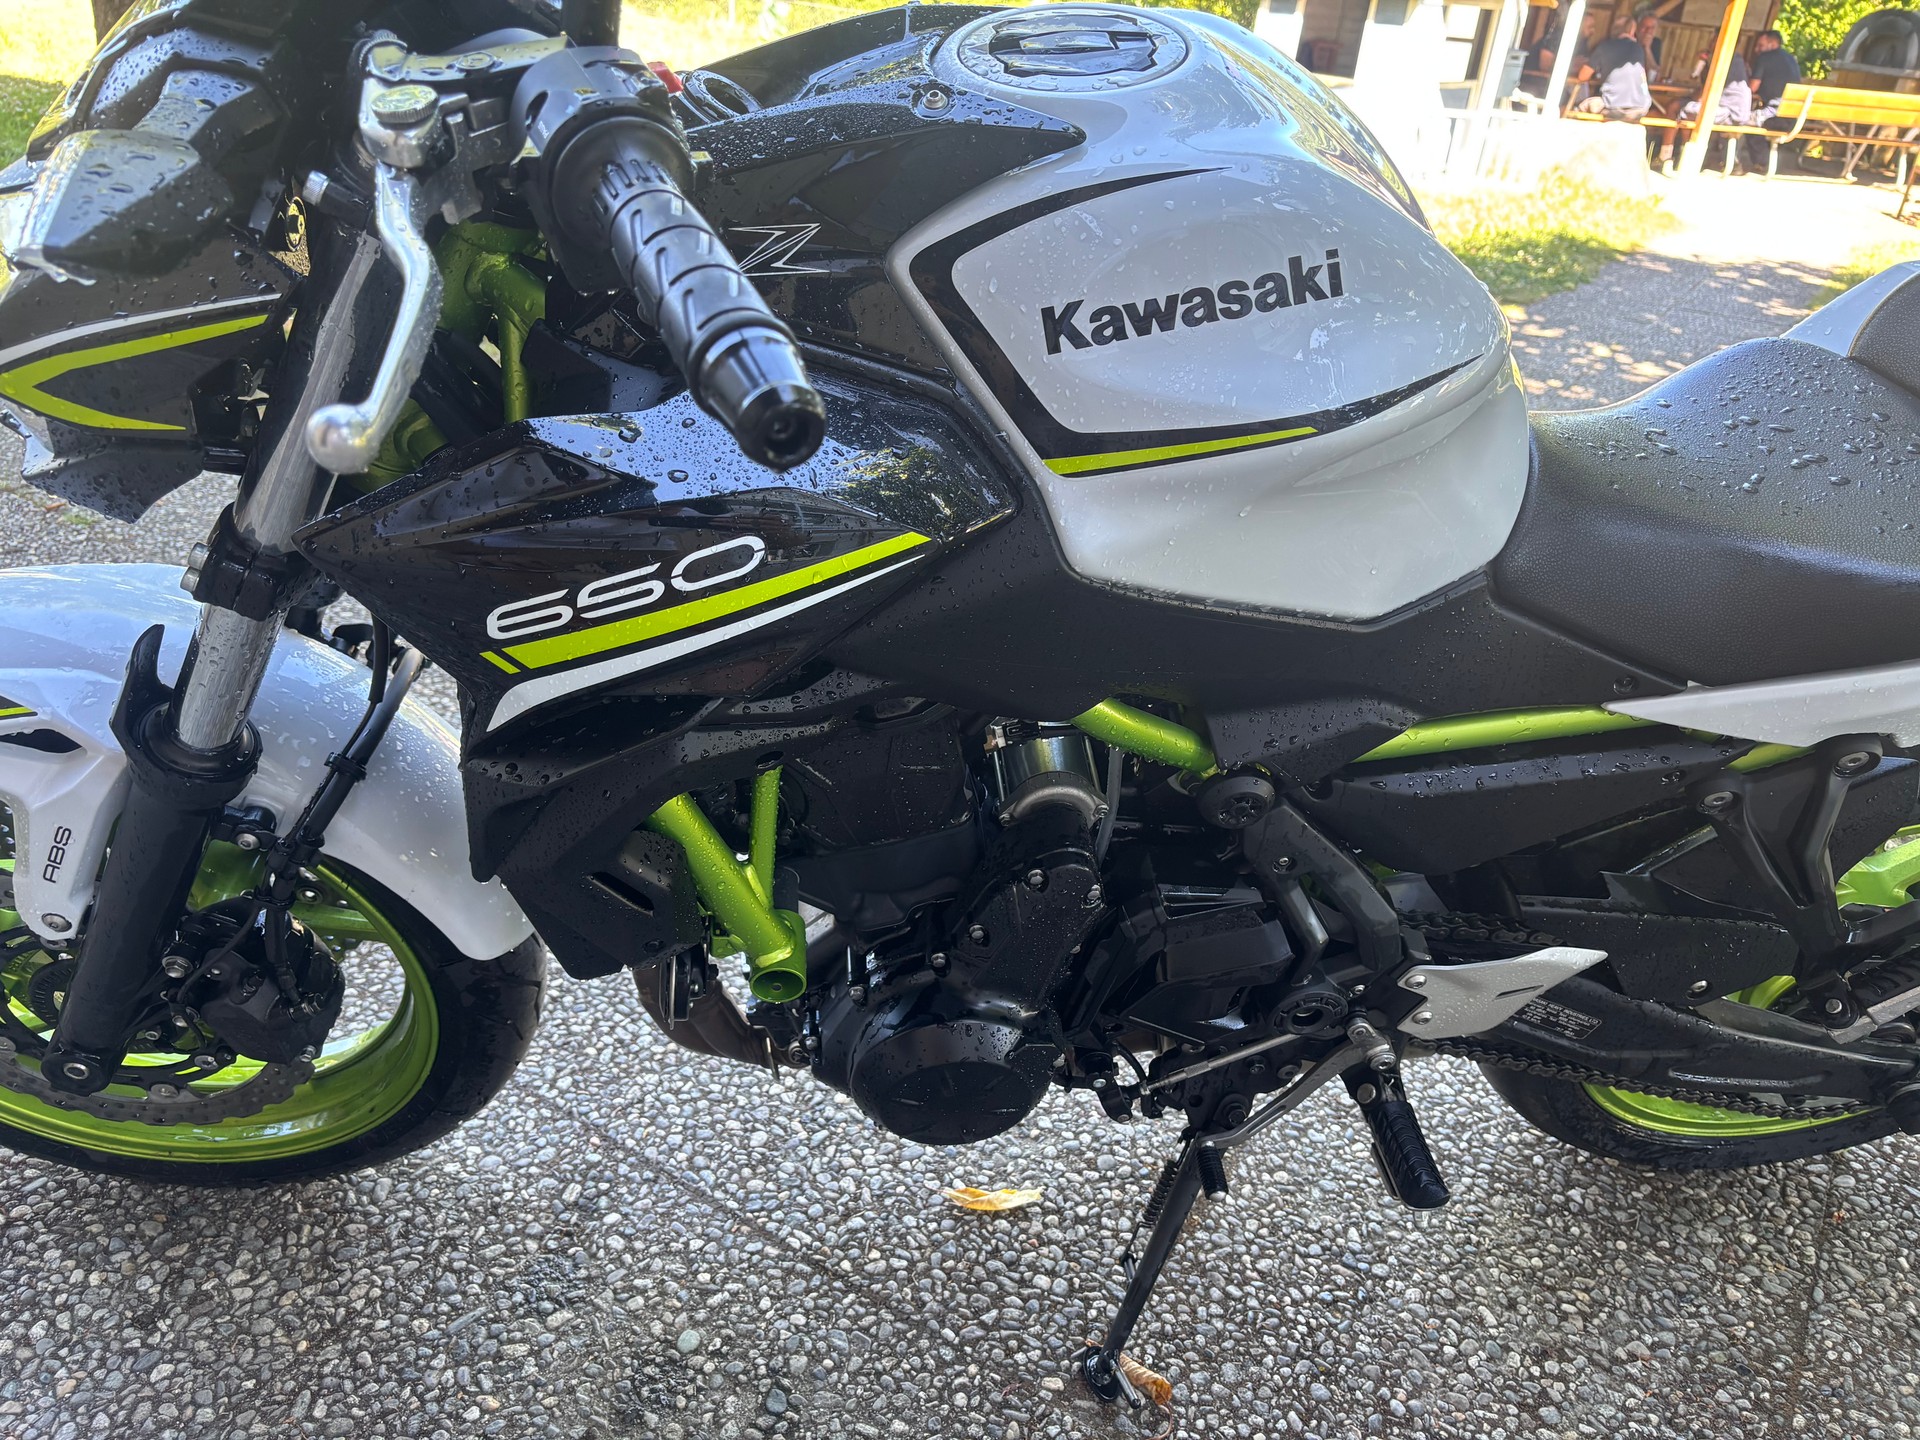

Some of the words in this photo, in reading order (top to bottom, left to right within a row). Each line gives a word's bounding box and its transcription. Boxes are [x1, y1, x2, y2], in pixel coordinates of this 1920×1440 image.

[1041, 248, 1344, 356] Kawasaki
[486, 535, 766, 640] 650
[43, 826, 72, 883] ABS
